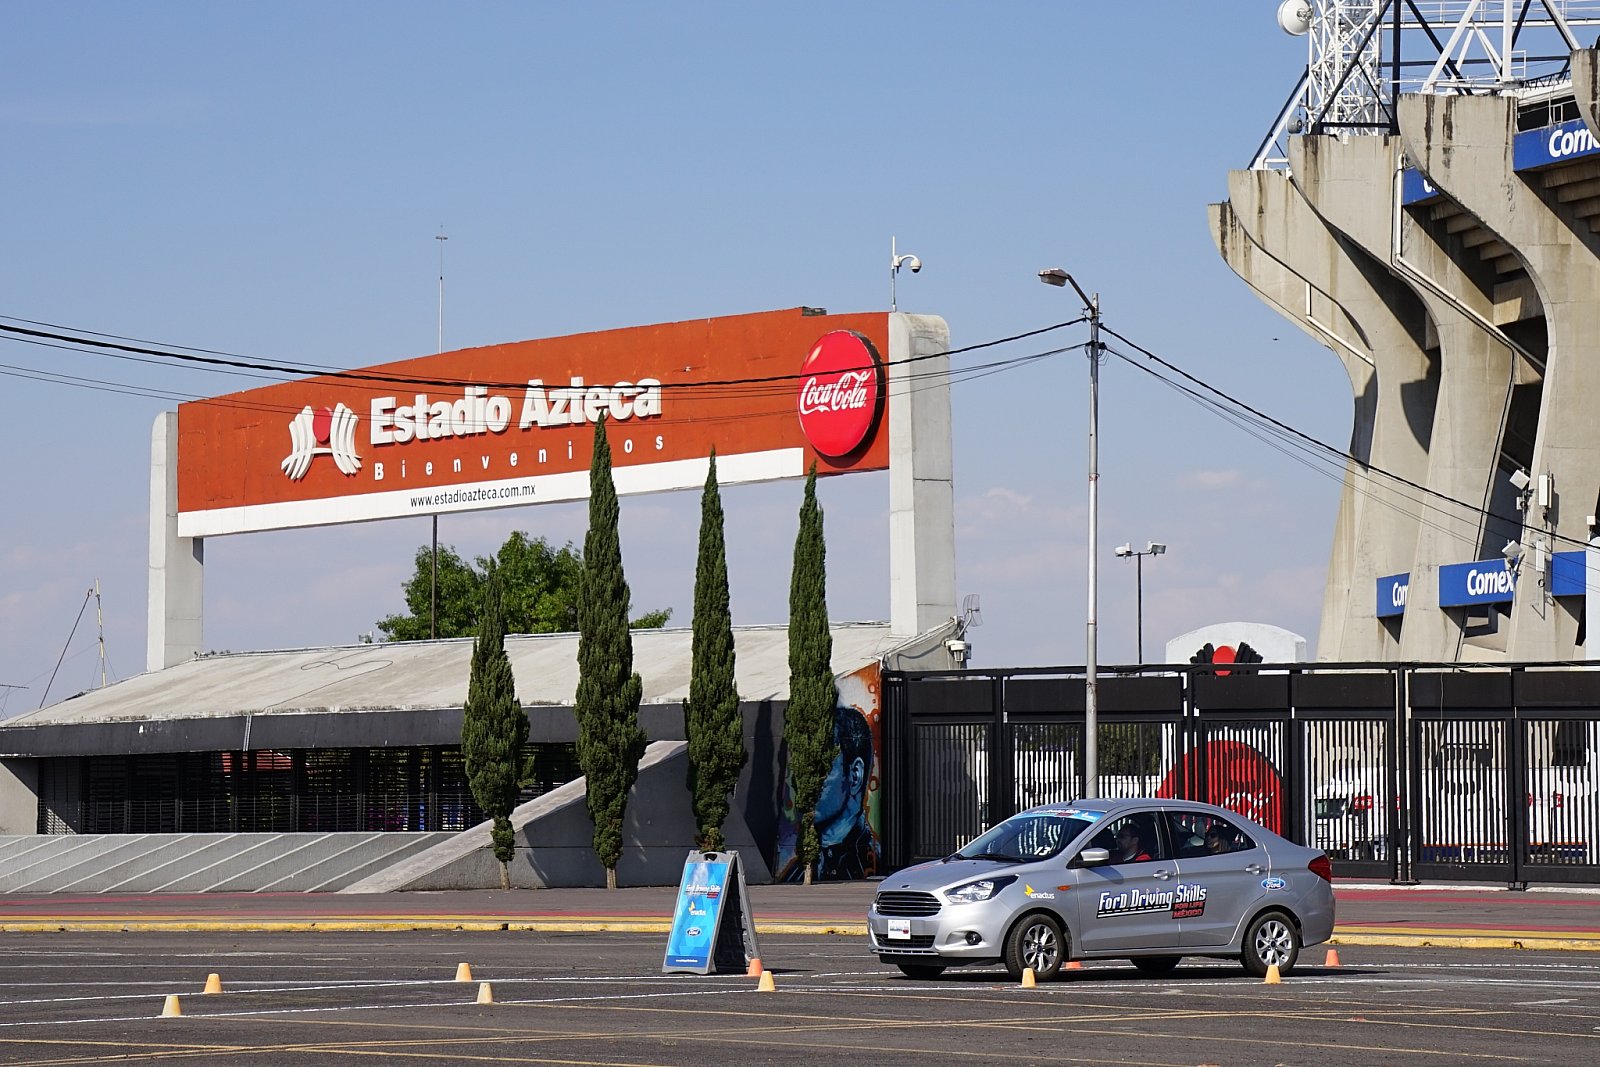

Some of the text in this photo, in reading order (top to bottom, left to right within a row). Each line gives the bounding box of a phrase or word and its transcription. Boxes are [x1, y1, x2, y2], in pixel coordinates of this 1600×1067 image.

[370, 376, 663, 446] Estadio Azteca
[374, 434, 664, 481] Bienvenios
[410, 484, 536, 508] www.estadioazteca.com.mx
[1467, 569, 1515, 596] Comex
[1030, 891, 1055, 900] enactus
[1130, 887, 1174, 910] Driving
[1175, 884, 1207, 904] Skills
